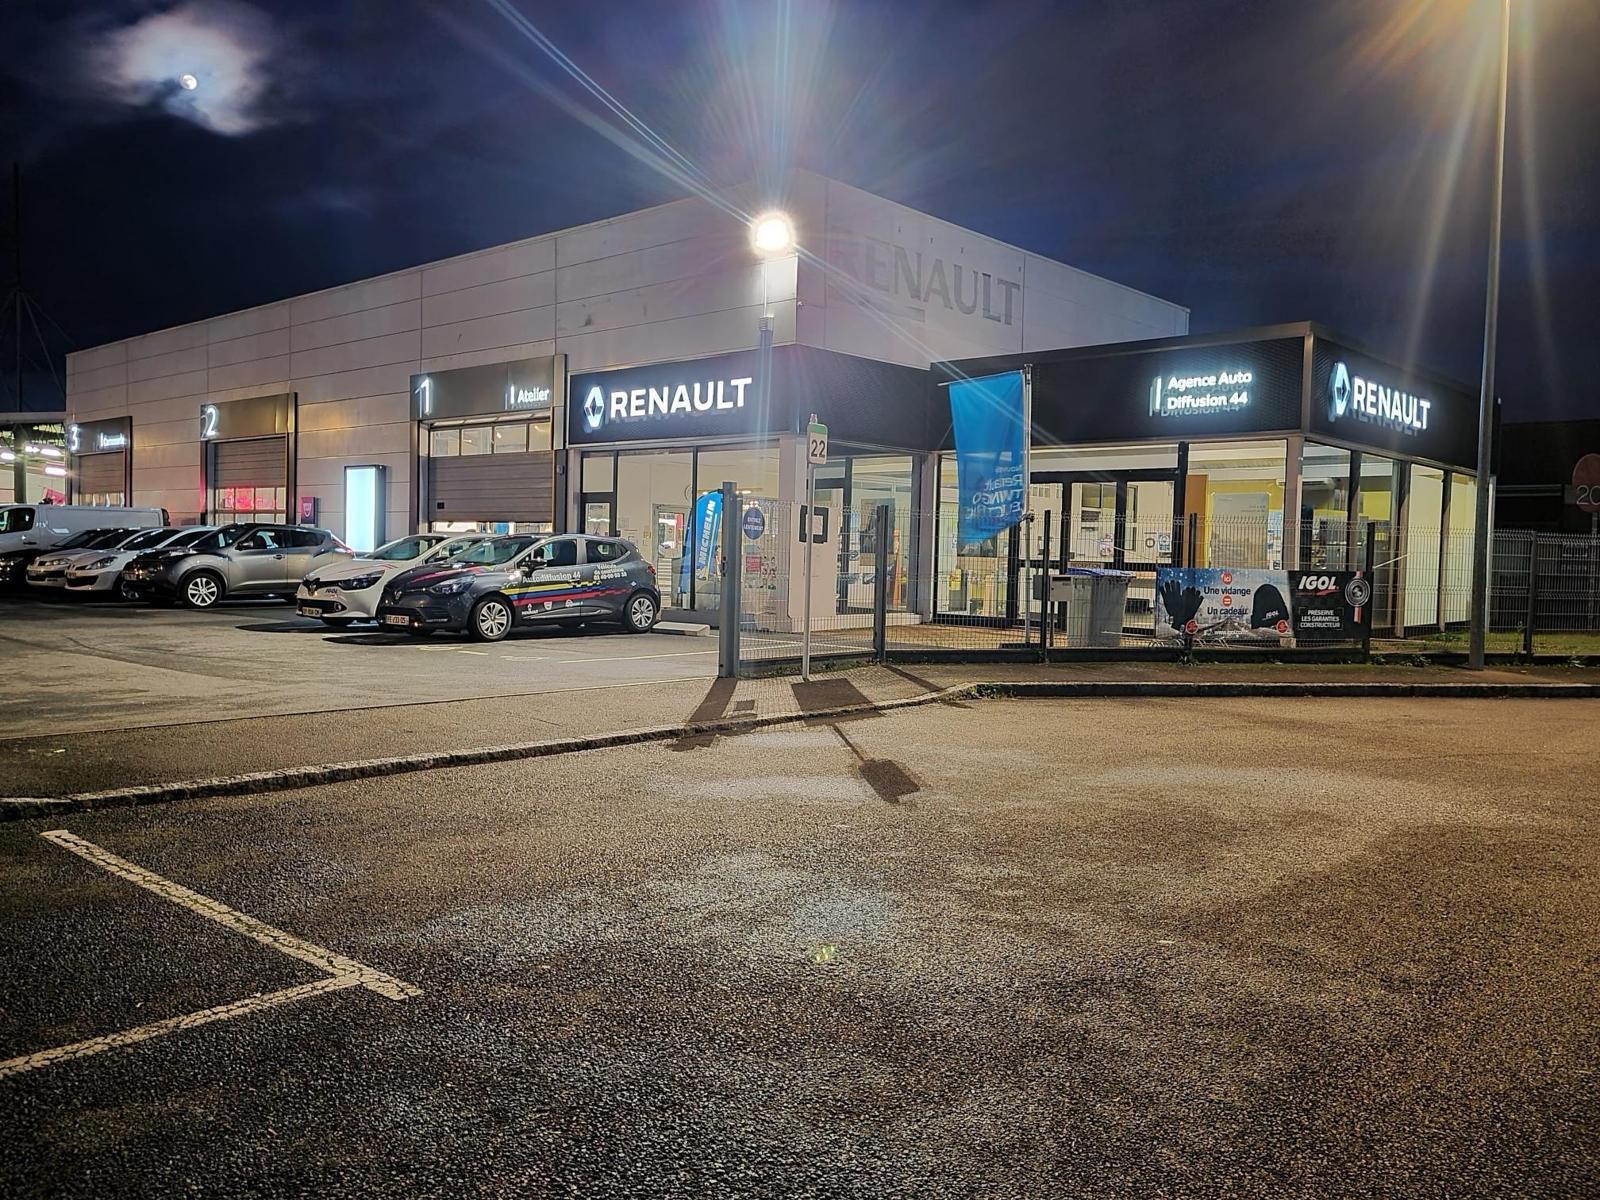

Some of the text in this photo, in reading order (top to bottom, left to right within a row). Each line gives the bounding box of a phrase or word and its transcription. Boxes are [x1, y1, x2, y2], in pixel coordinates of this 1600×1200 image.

[1167, 371, 1252, 391] Agence Auto
[419, 377, 430, 415] 1
[517, 387, 550, 403] Atelier
[610, 377, 752, 419] RENAULT
[1167, 391, 1248, 410] Diffusion 44
[1353, 376, 1431, 430] RENAULT
[206, 405, 218, 437] 2
[71, 425, 79, 452] 3
[811, 439, 826, 458] 22
[699, 500, 716, 564] MICHELIN
[1204, 586, 1251, 596] Une vidange
[1298, 575, 1337, 590] IGOL
[1207, 607, 1218, 615] Un
